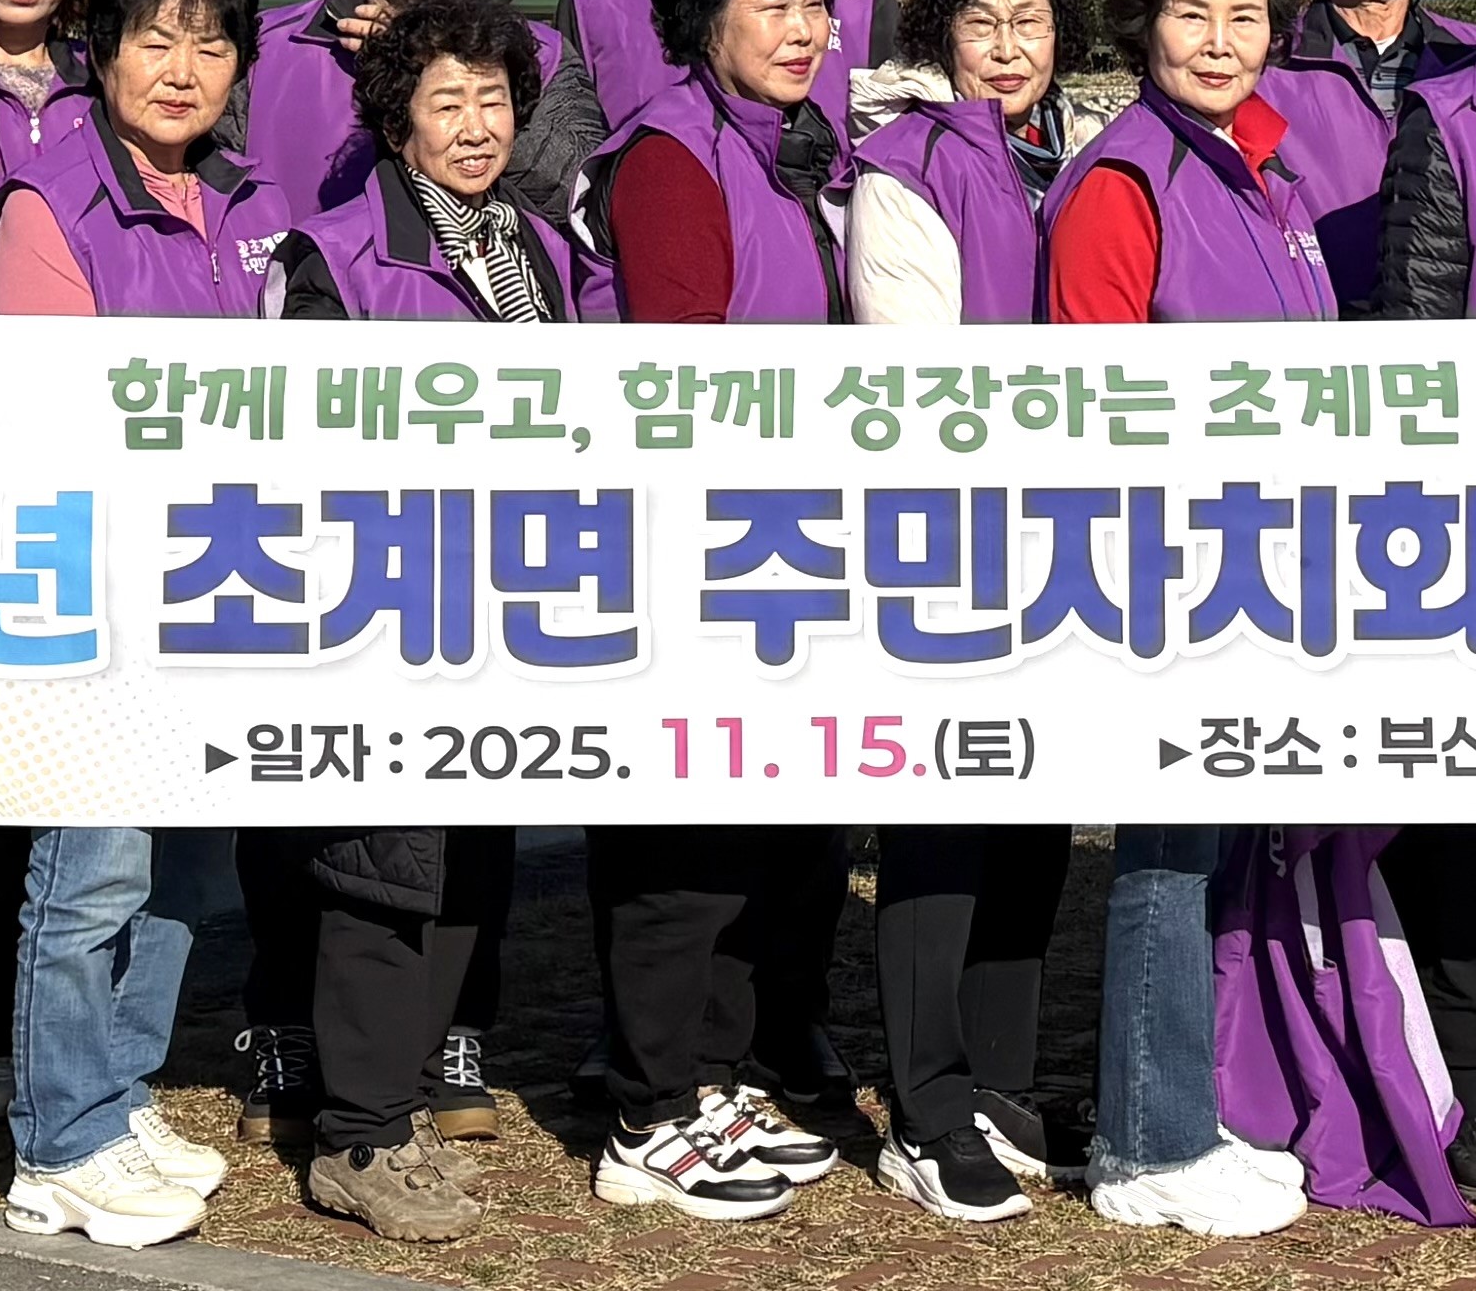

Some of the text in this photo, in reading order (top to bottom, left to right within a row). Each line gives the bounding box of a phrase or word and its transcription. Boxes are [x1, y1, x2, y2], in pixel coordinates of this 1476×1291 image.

[108, 357, 287, 451] 함께
[316, 362, 592, 455] 배우고,
[618, 362, 796, 451] 함께
[824, 364, 1176, 453] 성장하는
[1204, 360, 1460, 446] 초계면
[158, 482, 639, 668] 초계면
[423, 725, 631, 780] 2025.
[662, 718, 781, 777] 11.
